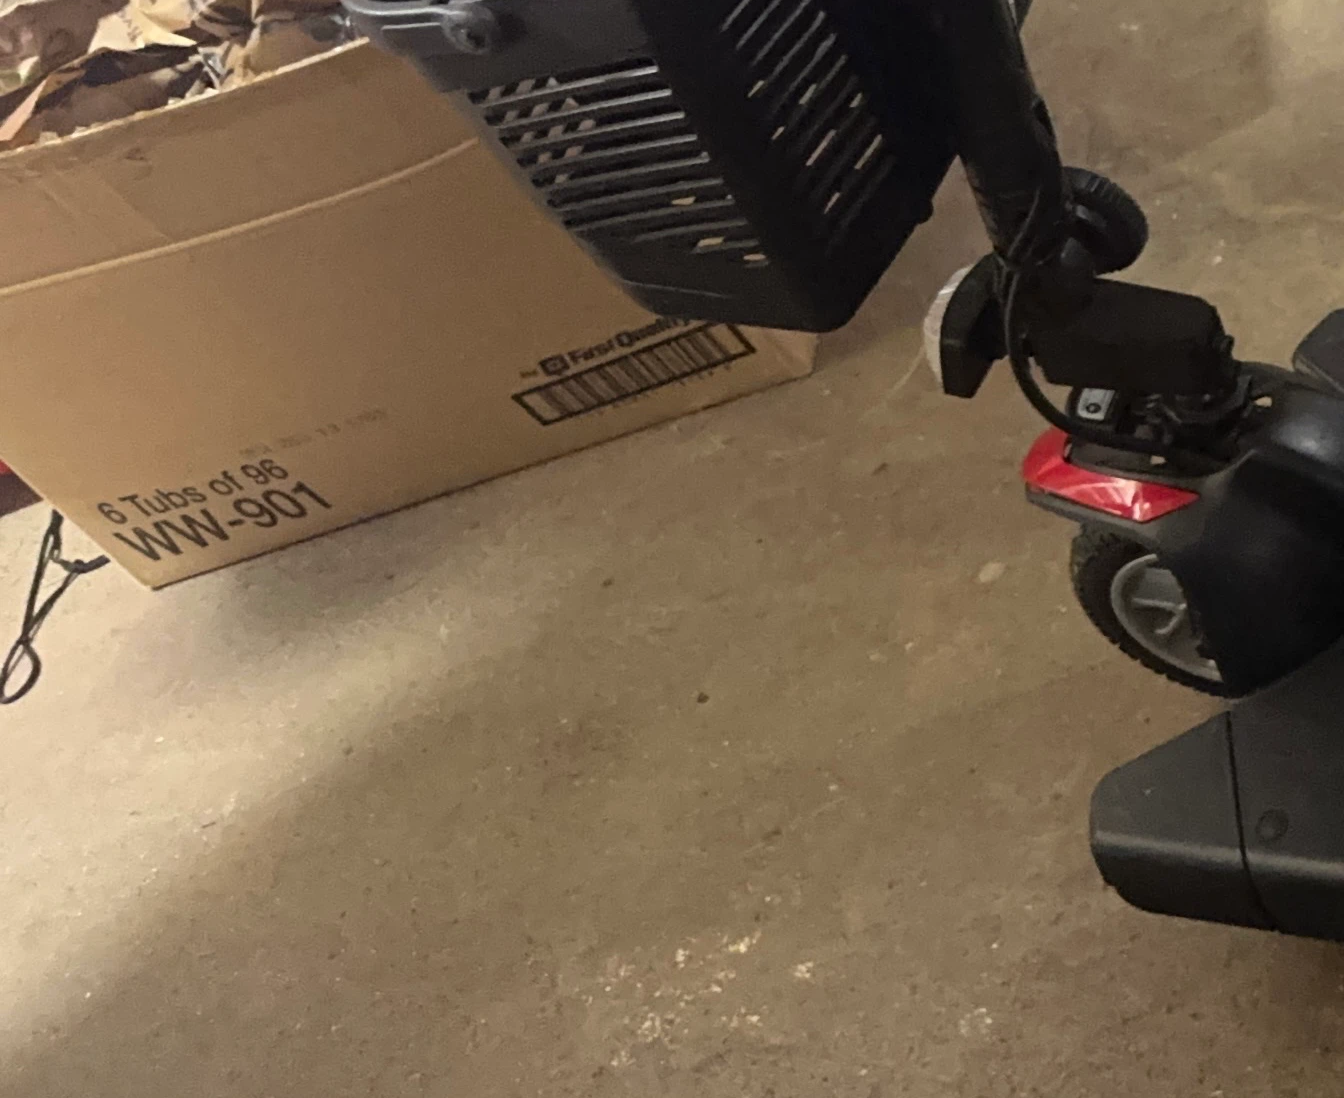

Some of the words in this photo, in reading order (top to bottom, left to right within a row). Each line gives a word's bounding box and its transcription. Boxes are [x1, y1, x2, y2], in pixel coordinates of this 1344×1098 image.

[97, 502, 128, 524] 6
[117, 488, 207, 517] Tubs
[208, 470, 244, 495] of
[240, 459, 289, 485] 96
[112, 481, 332, 562] WW-901
